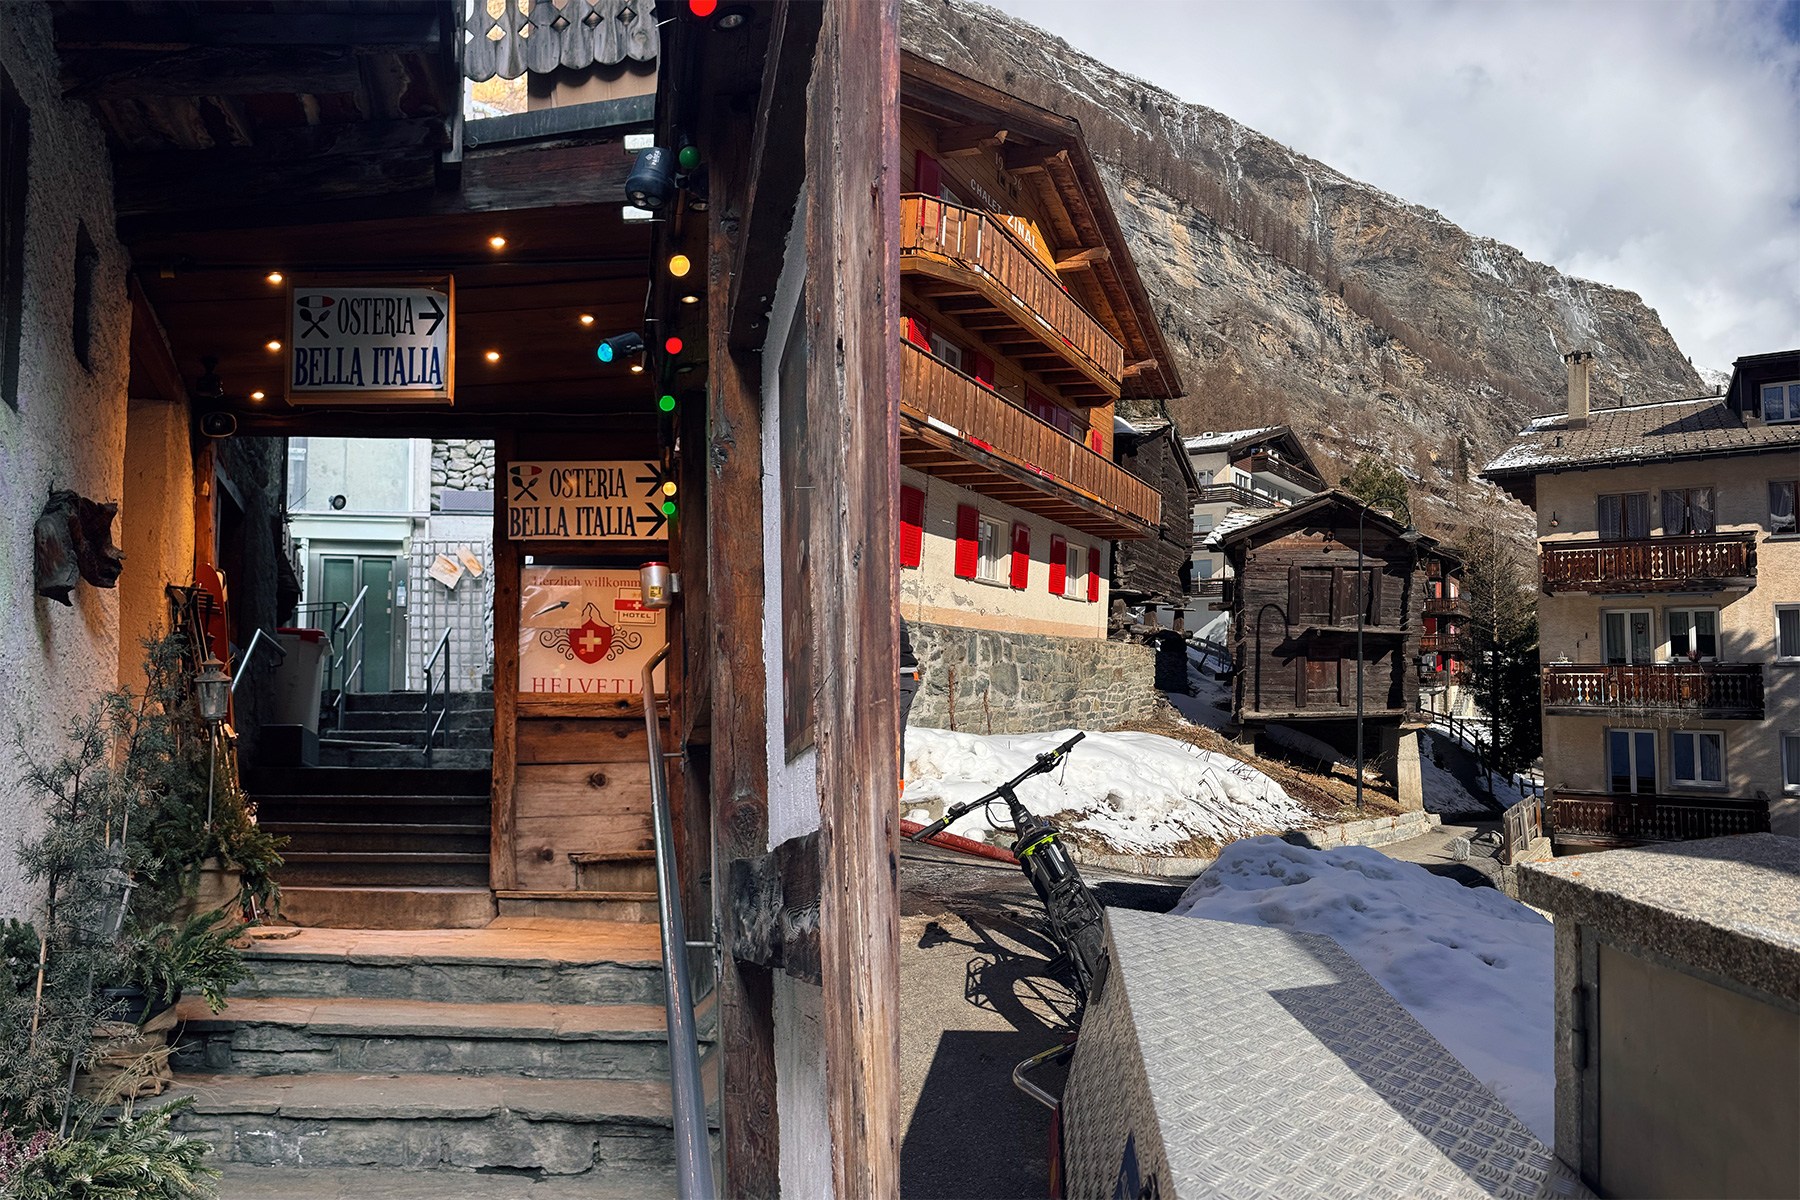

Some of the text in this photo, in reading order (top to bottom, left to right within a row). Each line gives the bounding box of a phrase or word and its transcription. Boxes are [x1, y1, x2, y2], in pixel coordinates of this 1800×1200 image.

[970, 178, 1038, 253] CHALET ZINAL
[337, 297, 415, 338] OSTERIA
[294, 346, 443, 387] BELLA ITALIA
[549, 467, 628, 500] OSTERIA
[509, 506, 637, 537] BELLA ITALIA
